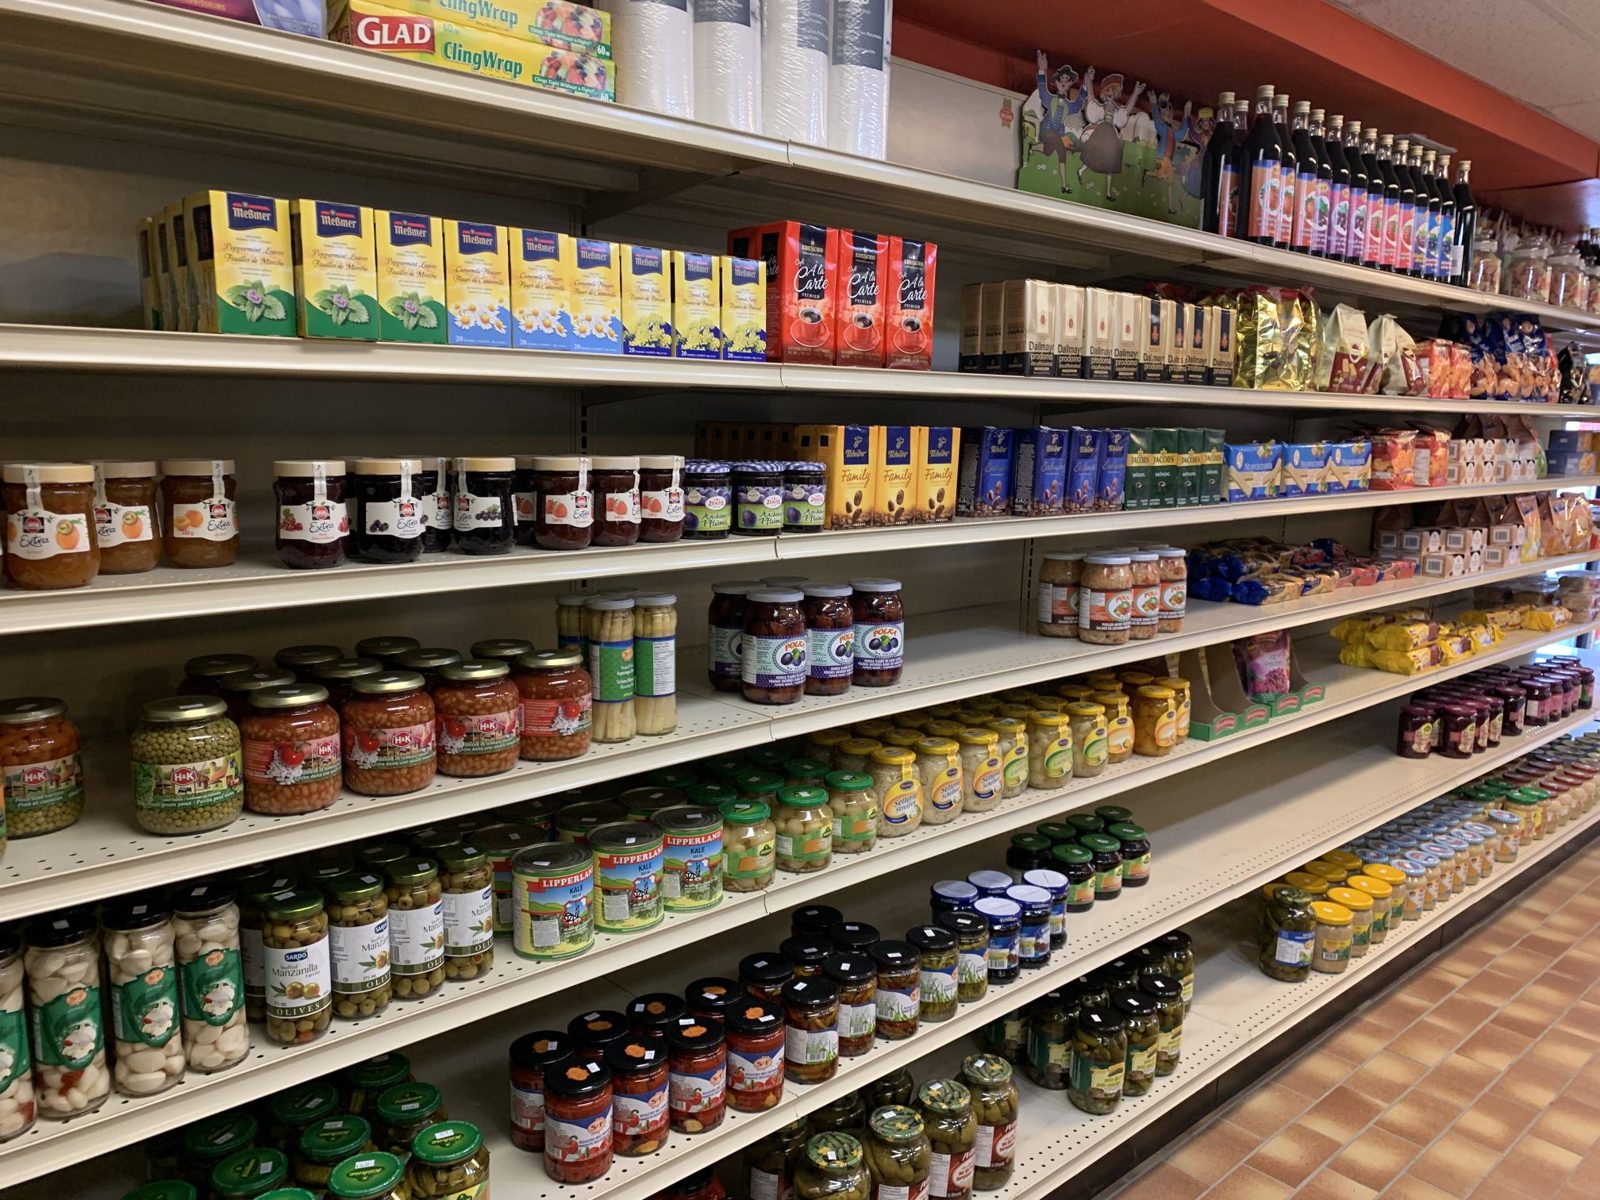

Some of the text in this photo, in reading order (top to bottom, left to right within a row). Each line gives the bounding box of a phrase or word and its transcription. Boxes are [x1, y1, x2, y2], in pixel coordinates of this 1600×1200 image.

[357, 16, 432, 46] GLAD
[443, 41, 523, 78] ClingWrap
[232, 206, 271, 223] Meßmer
[320, 214, 357, 230] Meßmer
[393, 225, 427, 239] Meßmer
[462, 234, 494, 247] Meßmer
[794, 266, 829, 293] Carte
[846, 273, 880, 298] Carte
[896, 279, 928, 303] Carte
[456, 335, 464, 343] 20
[1131, 456, 1149, 464] JACOBS
[1152, 456, 1174, 464] JACOBS
[1181, 456, 1200, 464] JACOBS
[841, 468, 870, 488] Family
[883, 468, 912, 488] Family
[925, 467, 952, 486] Family
[207, 519, 230, 532] Extra
[309, 521, 334, 533] Extra
[396, 518, 418, 530] Extra
[98, 525, 116, 537] xtra
[20, 534, 50, 548] Extra
[873, 627, 897, 637] POLKA
[480, 721, 496, 730] H&K
[395, 735, 412, 745] H&K
[319, 745, 332, 755] H&K
[25, 771, 46, 782] H&K
[174, 771, 195, 782] H&K
[668, 831, 721, 845] LIPPERLAND
[613, 845, 664, 865] LIPPERLAN
[691, 846, 705, 855] KALE
[638, 862, 652, 872] KALE
[543, 867, 593, 888] LIPPERLAN
[570, 884, 583, 895] KALE
[375, 921, 388, 932] SARD
[475, 939, 491, 952] OLI
[285, 952, 307, 960] SARDO
[427, 956, 444, 969] OLI
[272, 963, 318, 977] Manzanilla
[366, 973, 391, 989] OLIV
[276, 1002, 320, 1016] OLIVES
